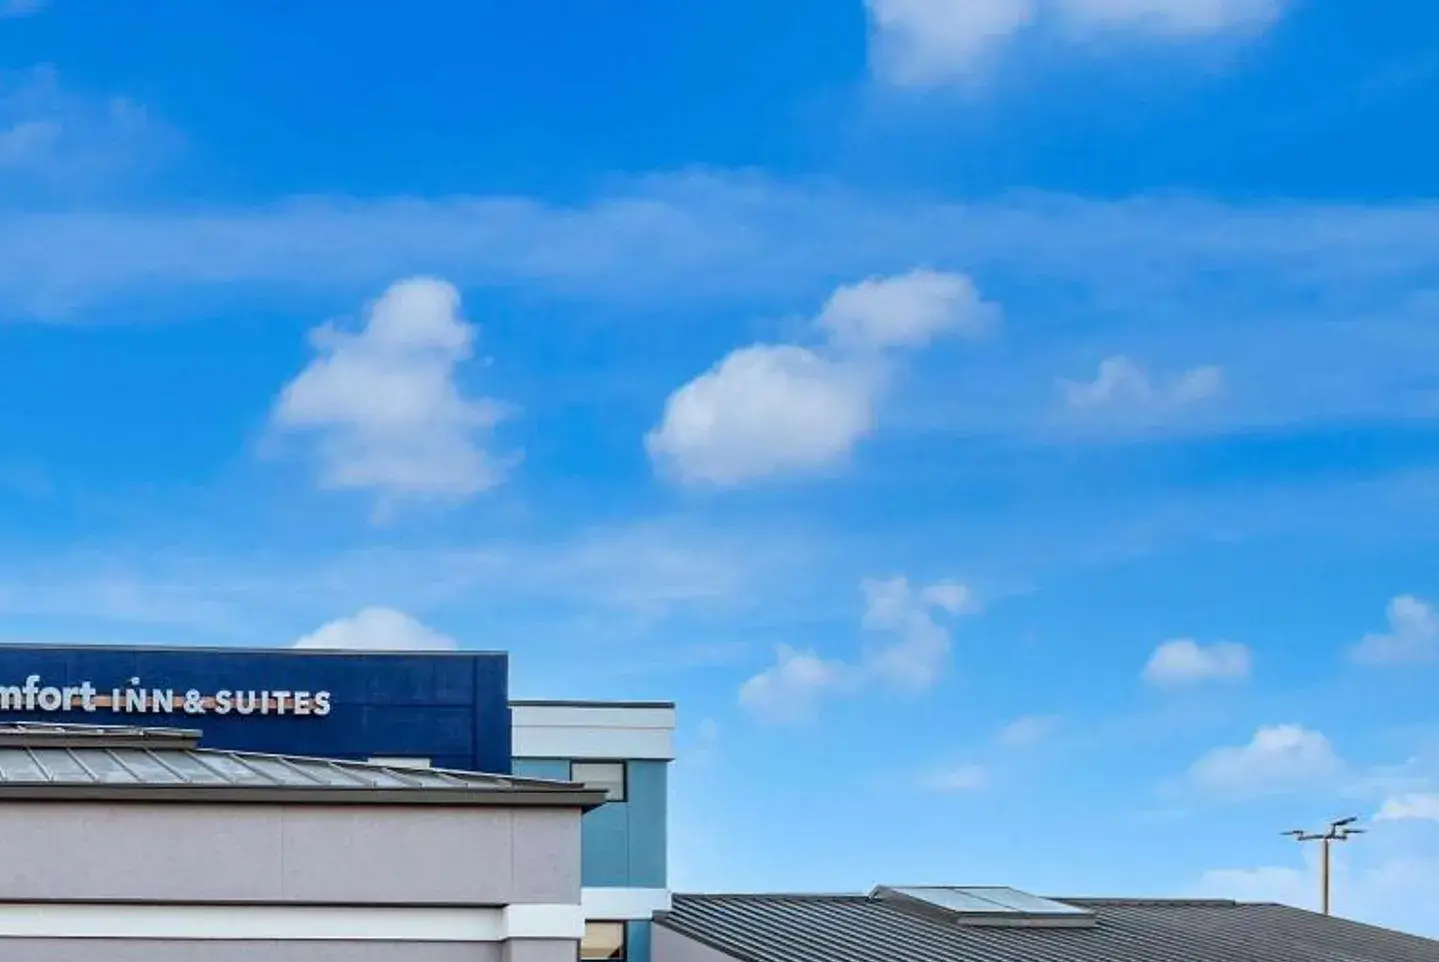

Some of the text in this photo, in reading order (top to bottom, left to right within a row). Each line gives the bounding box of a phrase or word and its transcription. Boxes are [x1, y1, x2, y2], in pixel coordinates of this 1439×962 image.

[112, 688, 174, 713] INN
[183, 688, 207, 714] &
[214, 689, 331, 716] SUITES
